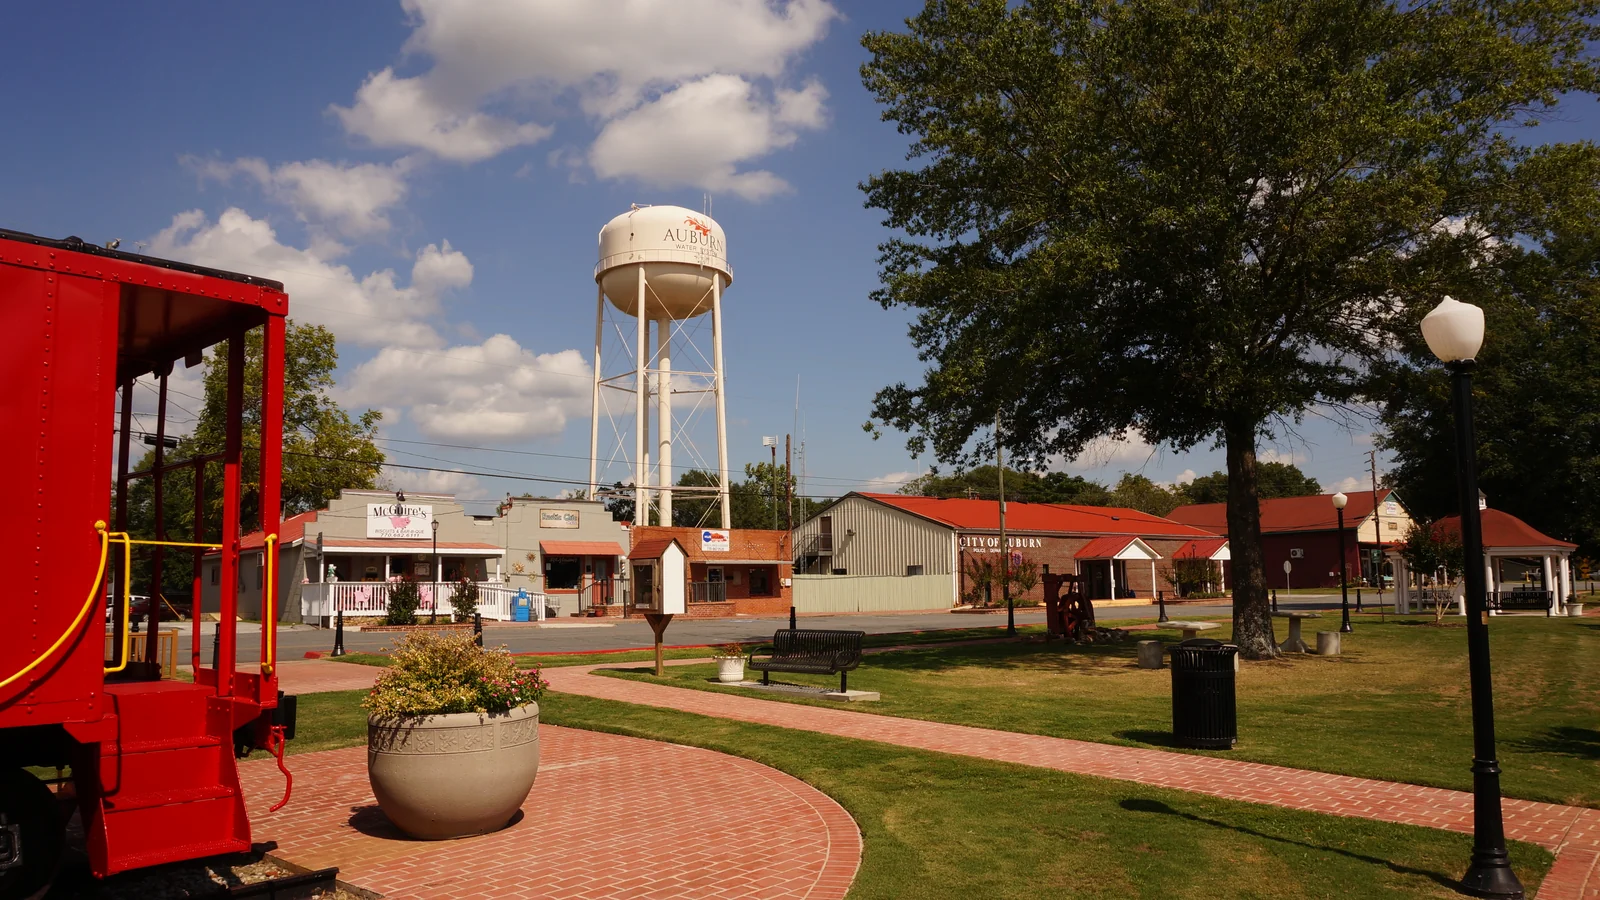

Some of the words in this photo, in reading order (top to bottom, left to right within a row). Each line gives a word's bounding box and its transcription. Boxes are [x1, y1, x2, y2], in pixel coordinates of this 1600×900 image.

[663, 228, 723, 252] AUBURN
[675, 243, 697, 251] WATER
[373, 504, 427, 518] McGuire's
[959, 537, 986, 547] CITY
[987, 537, 1000, 548] OF
[1004, 537, 1042, 548] UBURN
